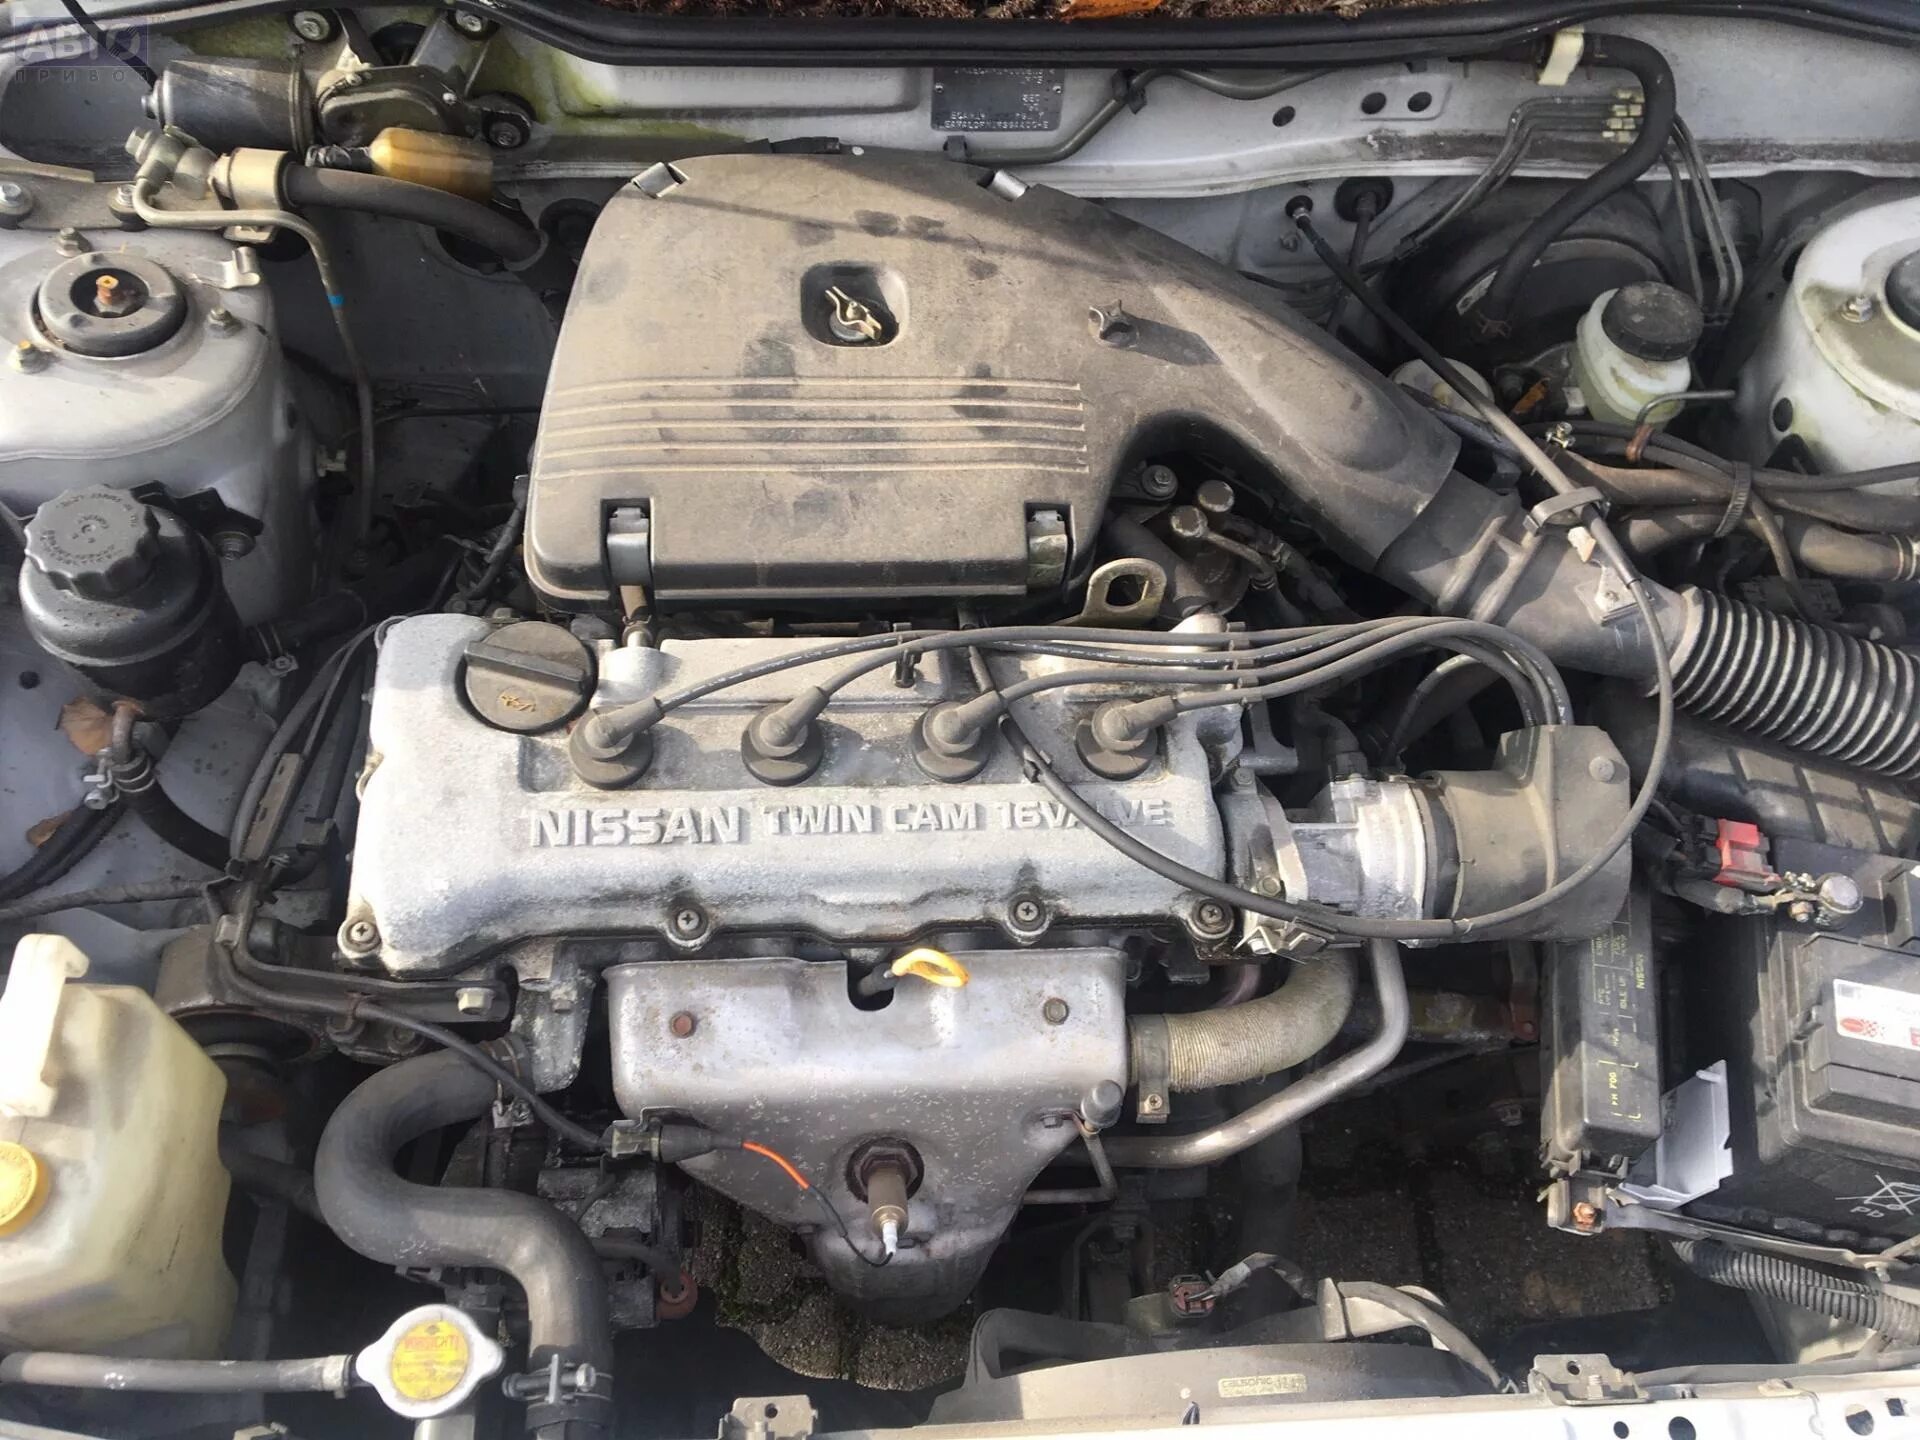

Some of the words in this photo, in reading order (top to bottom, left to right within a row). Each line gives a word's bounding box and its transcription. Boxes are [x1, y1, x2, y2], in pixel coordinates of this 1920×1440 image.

[529, 806, 743, 848] NISSAN
[763, 803, 874, 835] TWIN
[885, 802, 979, 832] CAM
[994, 798, 1165, 828] 16VVE
